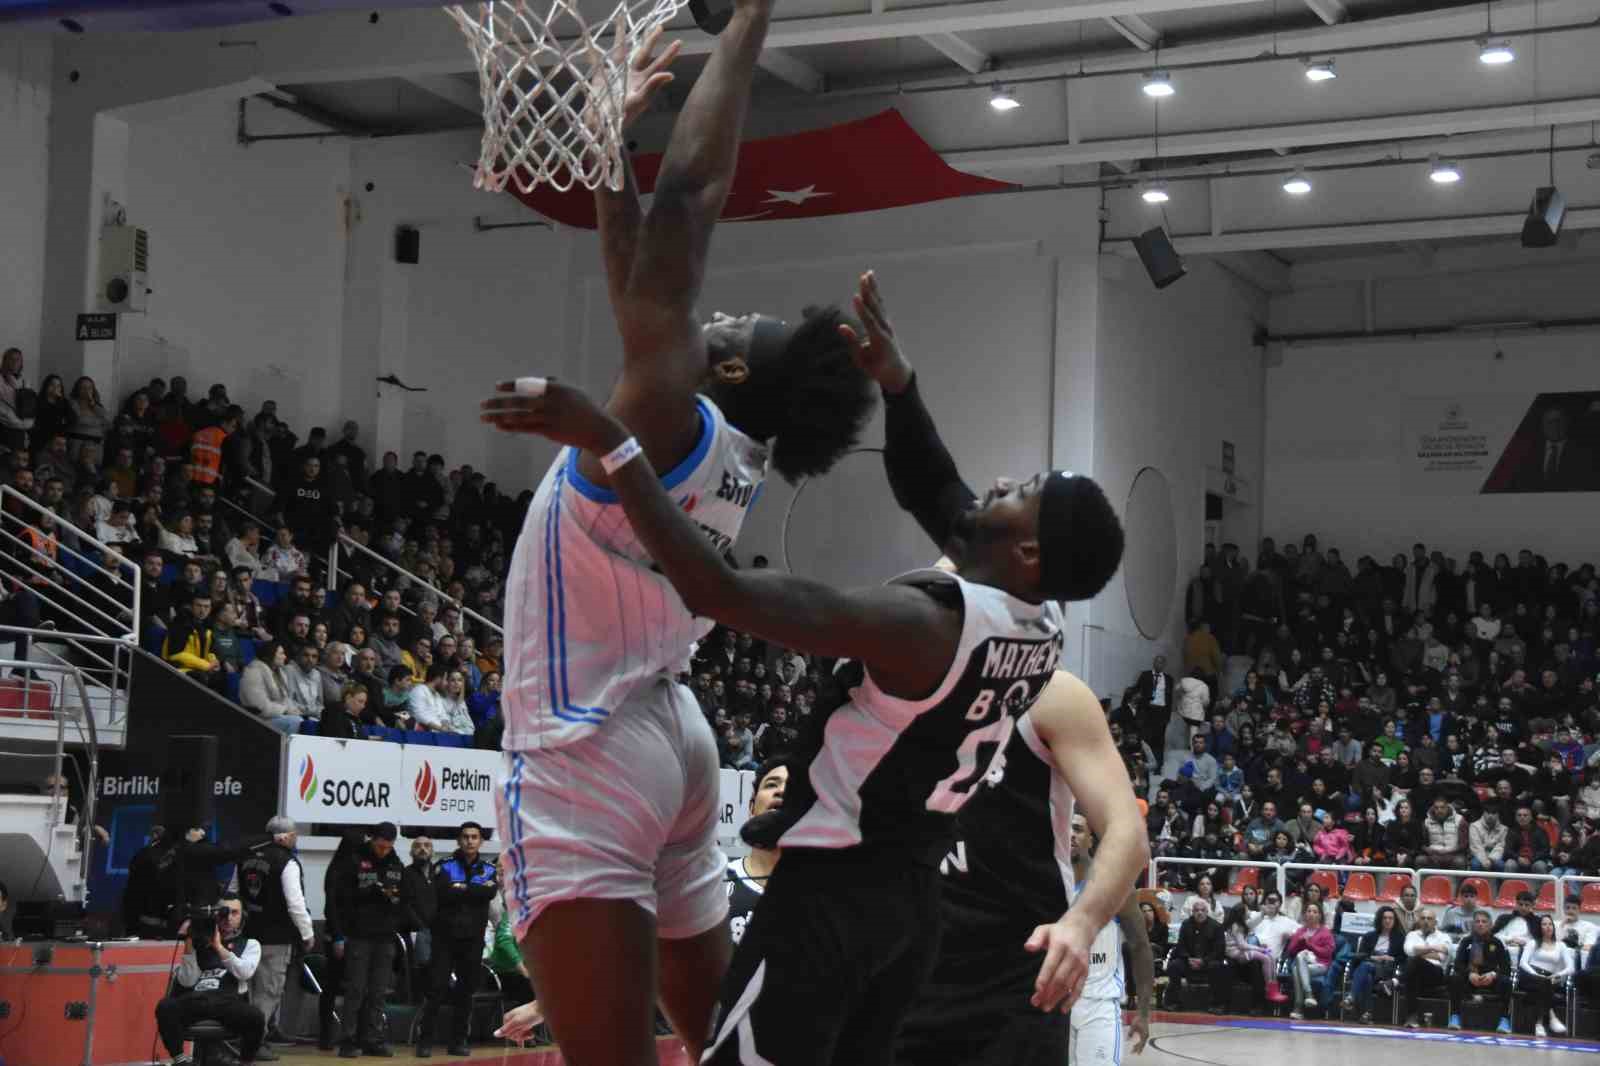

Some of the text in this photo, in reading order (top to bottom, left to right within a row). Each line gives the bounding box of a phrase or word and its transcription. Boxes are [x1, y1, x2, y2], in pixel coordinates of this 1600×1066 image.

[80, 324, 89, 338] A
[442, 767, 490, 792] Petkim
[322, 779, 390, 808] SOCAR
[440, 799, 475, 812] SPOR
